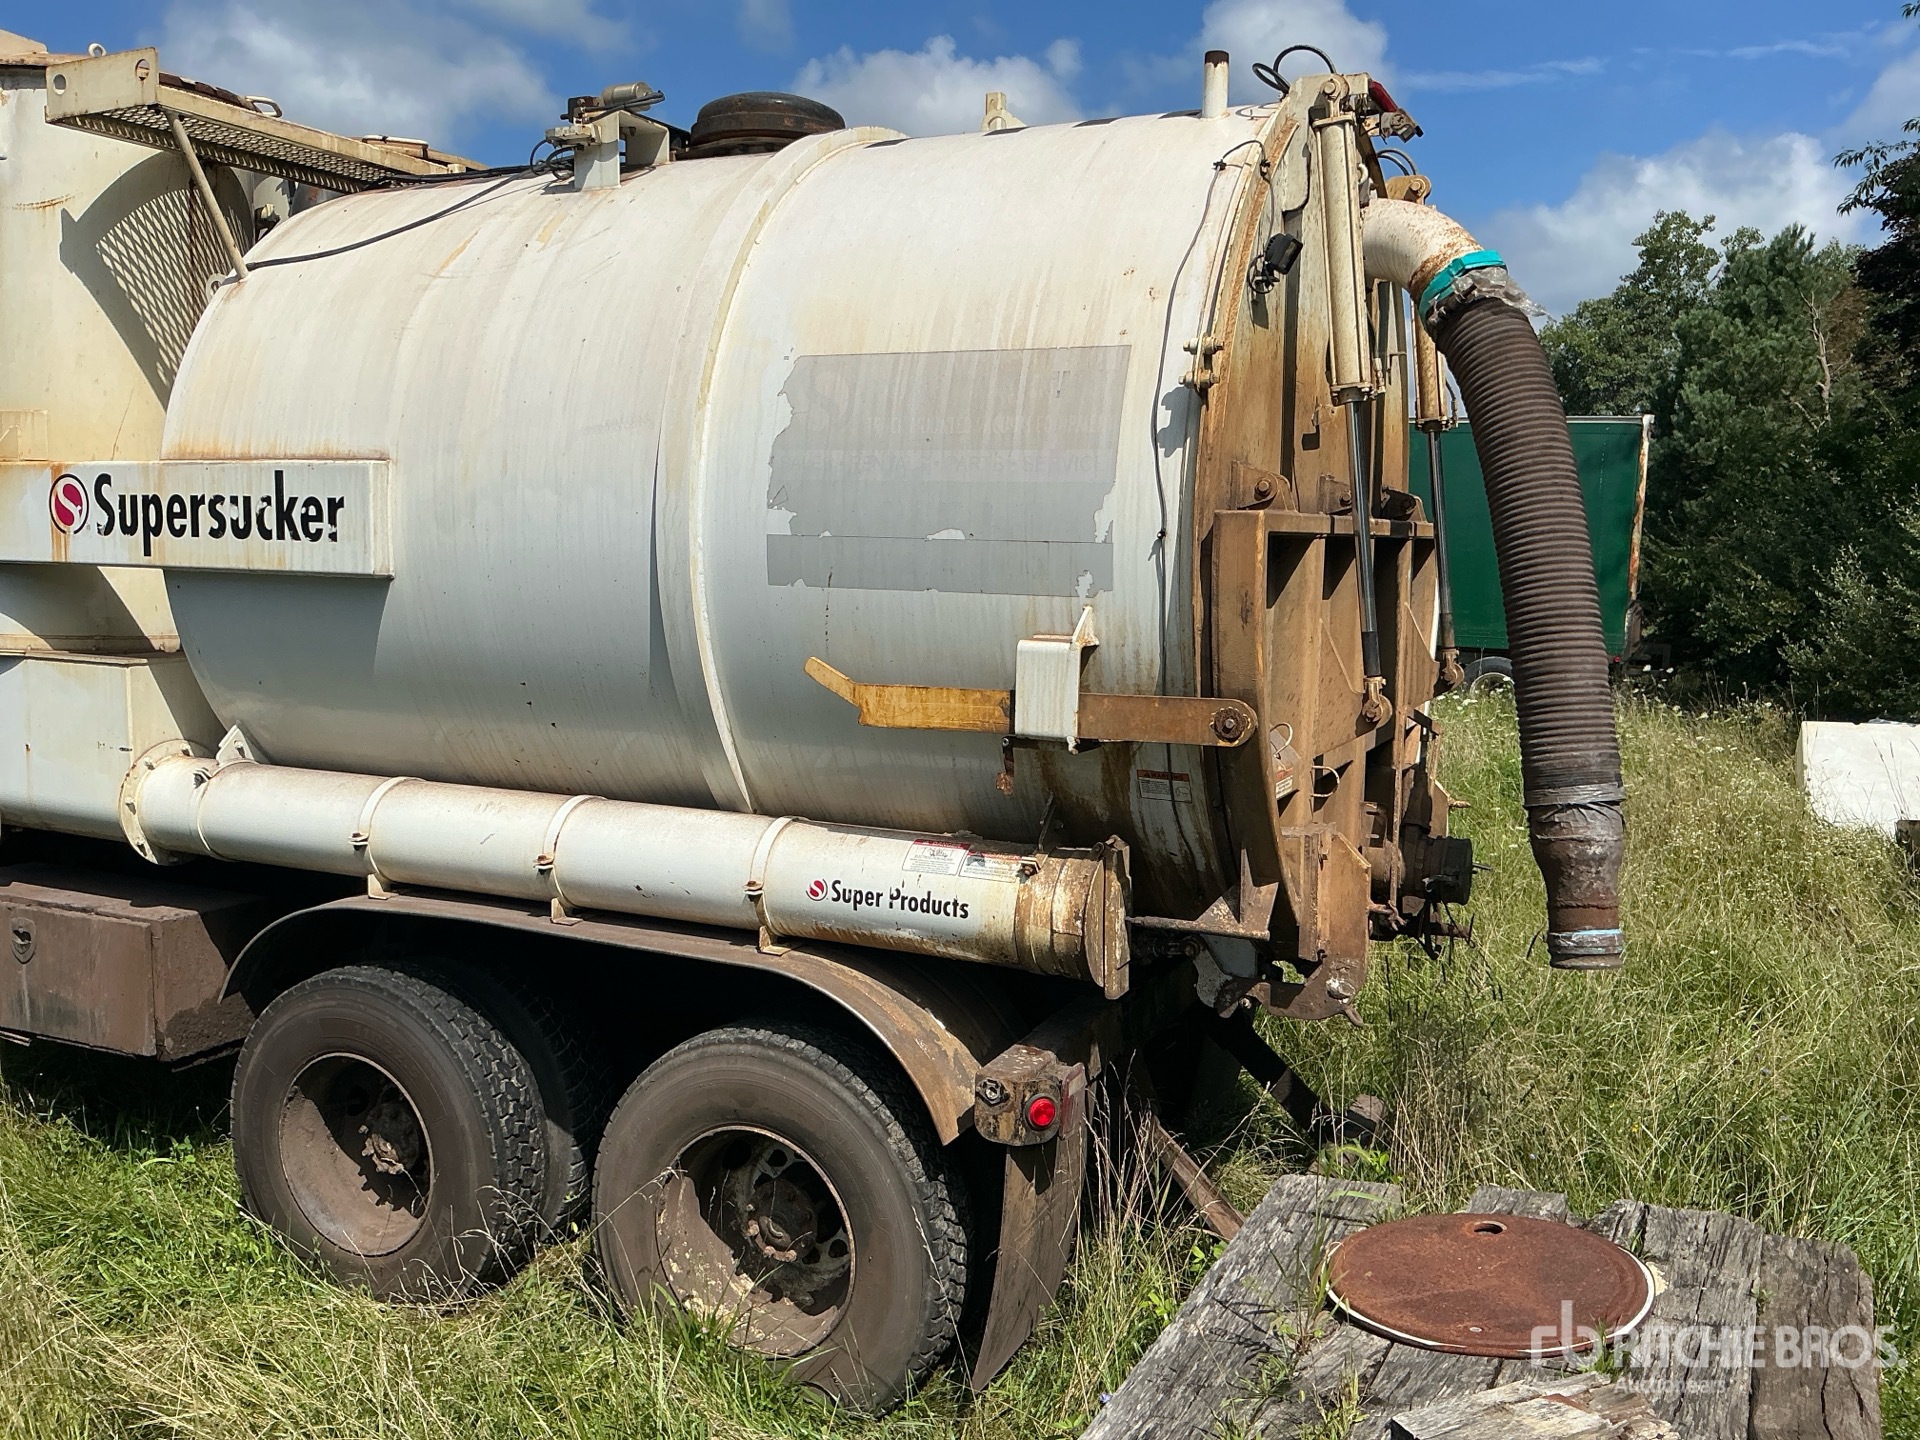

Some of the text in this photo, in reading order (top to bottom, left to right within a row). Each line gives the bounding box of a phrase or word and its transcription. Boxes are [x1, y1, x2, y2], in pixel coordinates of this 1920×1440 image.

[94, 470, 345, 557] Supersucker
[831, 879, 883, 911] Super
[889, 886, 969, 919] Products
